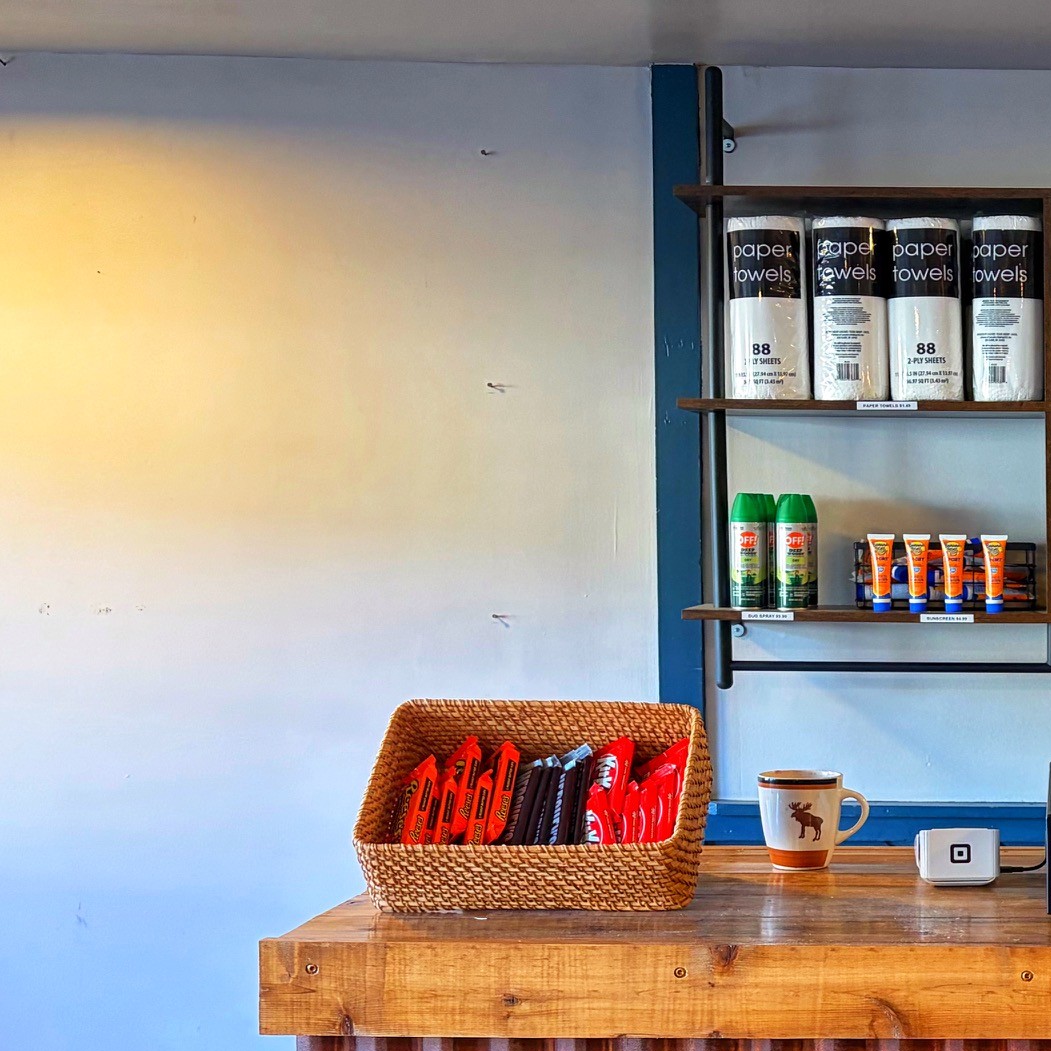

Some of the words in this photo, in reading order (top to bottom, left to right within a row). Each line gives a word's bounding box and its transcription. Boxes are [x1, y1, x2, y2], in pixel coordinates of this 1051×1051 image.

[733, 243, 793, 261] paper
[892, 242, 953, 261] paper
[733, 265, 792, 282] towels
[892, 264, 953, 282] towels
[752, 343, 771, 355] 88
[916, 342, 936, 354] 88
[759, 357, 782, 365] SHEETS
[925, 356, 946, 364] SHEETS
[740, 535, 758, 546] OFF!
[786, 535, 805, 546] OFF!
